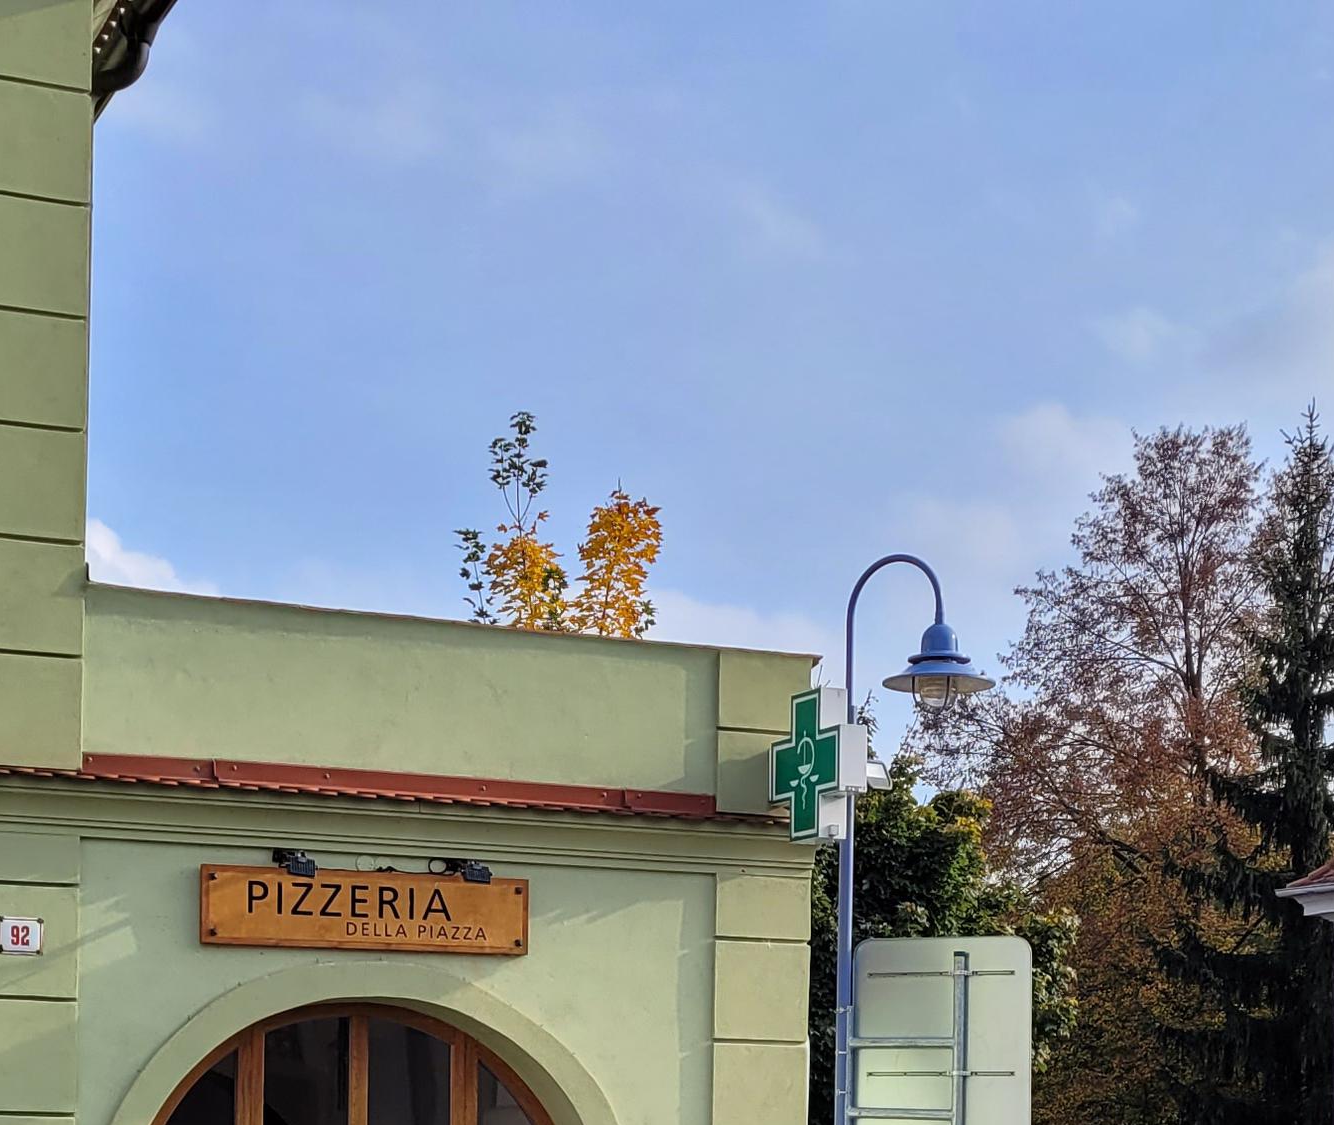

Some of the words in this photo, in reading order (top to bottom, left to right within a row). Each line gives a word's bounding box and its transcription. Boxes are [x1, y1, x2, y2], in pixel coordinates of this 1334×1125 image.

[247, 879, 452, 922] PIZZERIA
[9, 925, 31, 946] 92
[346, 921, 407, 939] DELLA
[417, 924, 488, 942] PIAZZA
